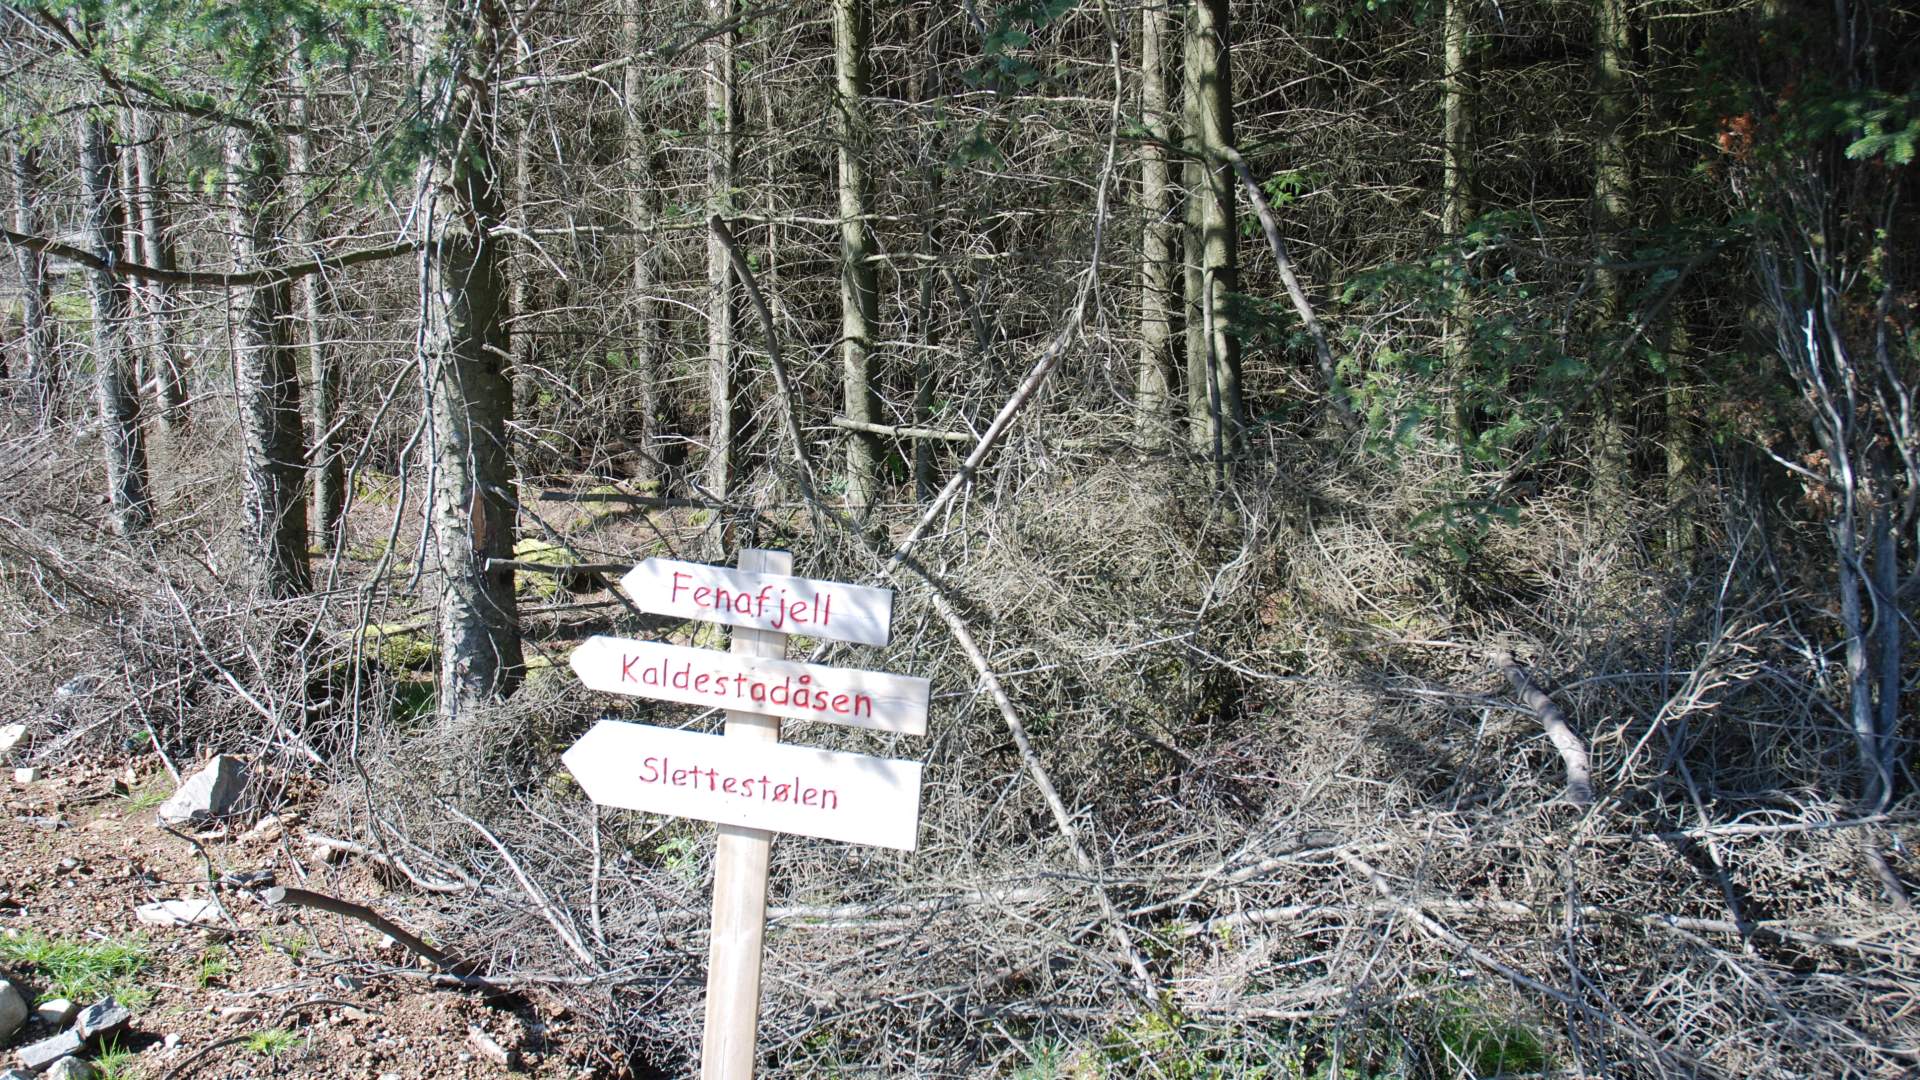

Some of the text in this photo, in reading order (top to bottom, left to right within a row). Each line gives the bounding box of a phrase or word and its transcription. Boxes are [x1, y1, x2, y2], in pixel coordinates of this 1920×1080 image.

[672, 571, 832, 629] Fenafjell
[622, 653, 873, 718] Kaldestadåsen
[639, 756, 839, 810] Slettestølen
